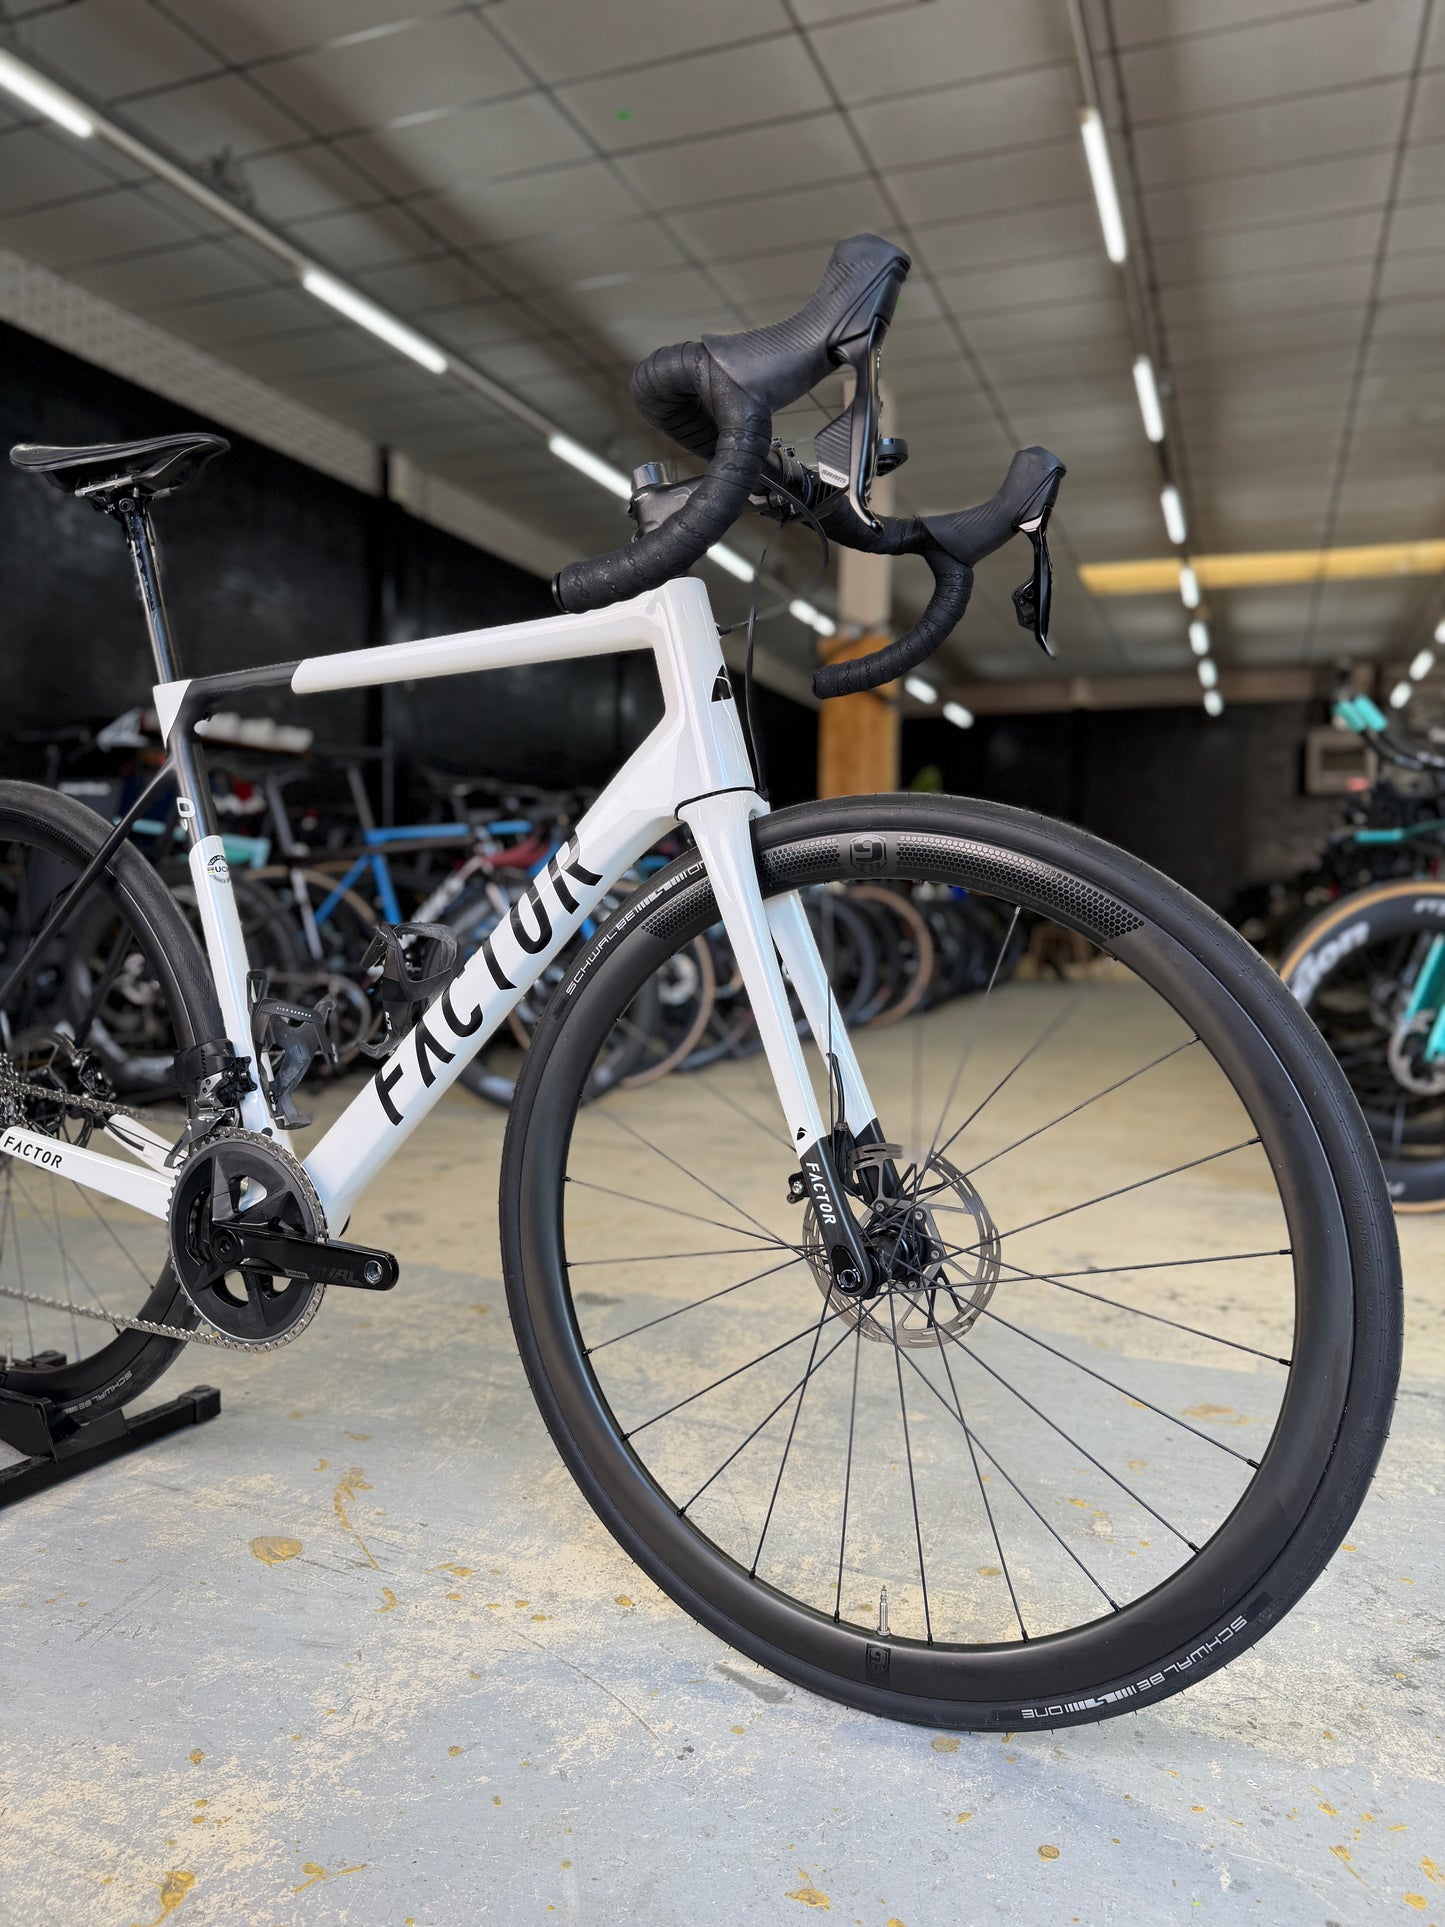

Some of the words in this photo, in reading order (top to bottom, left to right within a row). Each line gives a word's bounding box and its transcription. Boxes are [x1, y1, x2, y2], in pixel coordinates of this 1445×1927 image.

[822, 469, 847, 483] SRAM
[566, 911, 636, 995] SCHWALBE
[375, 834, 603, 1126] FACTOR
[3, 1135, 63, 1169] FACTOR
[805, 1162, 836, 1225] FACTOR
[79, 1370, 133, 1410] SCHWALBE
[1137, 1615, 1248, 1692] SCHWALBE
[1021, 1709, 1063, 1719] ONE
